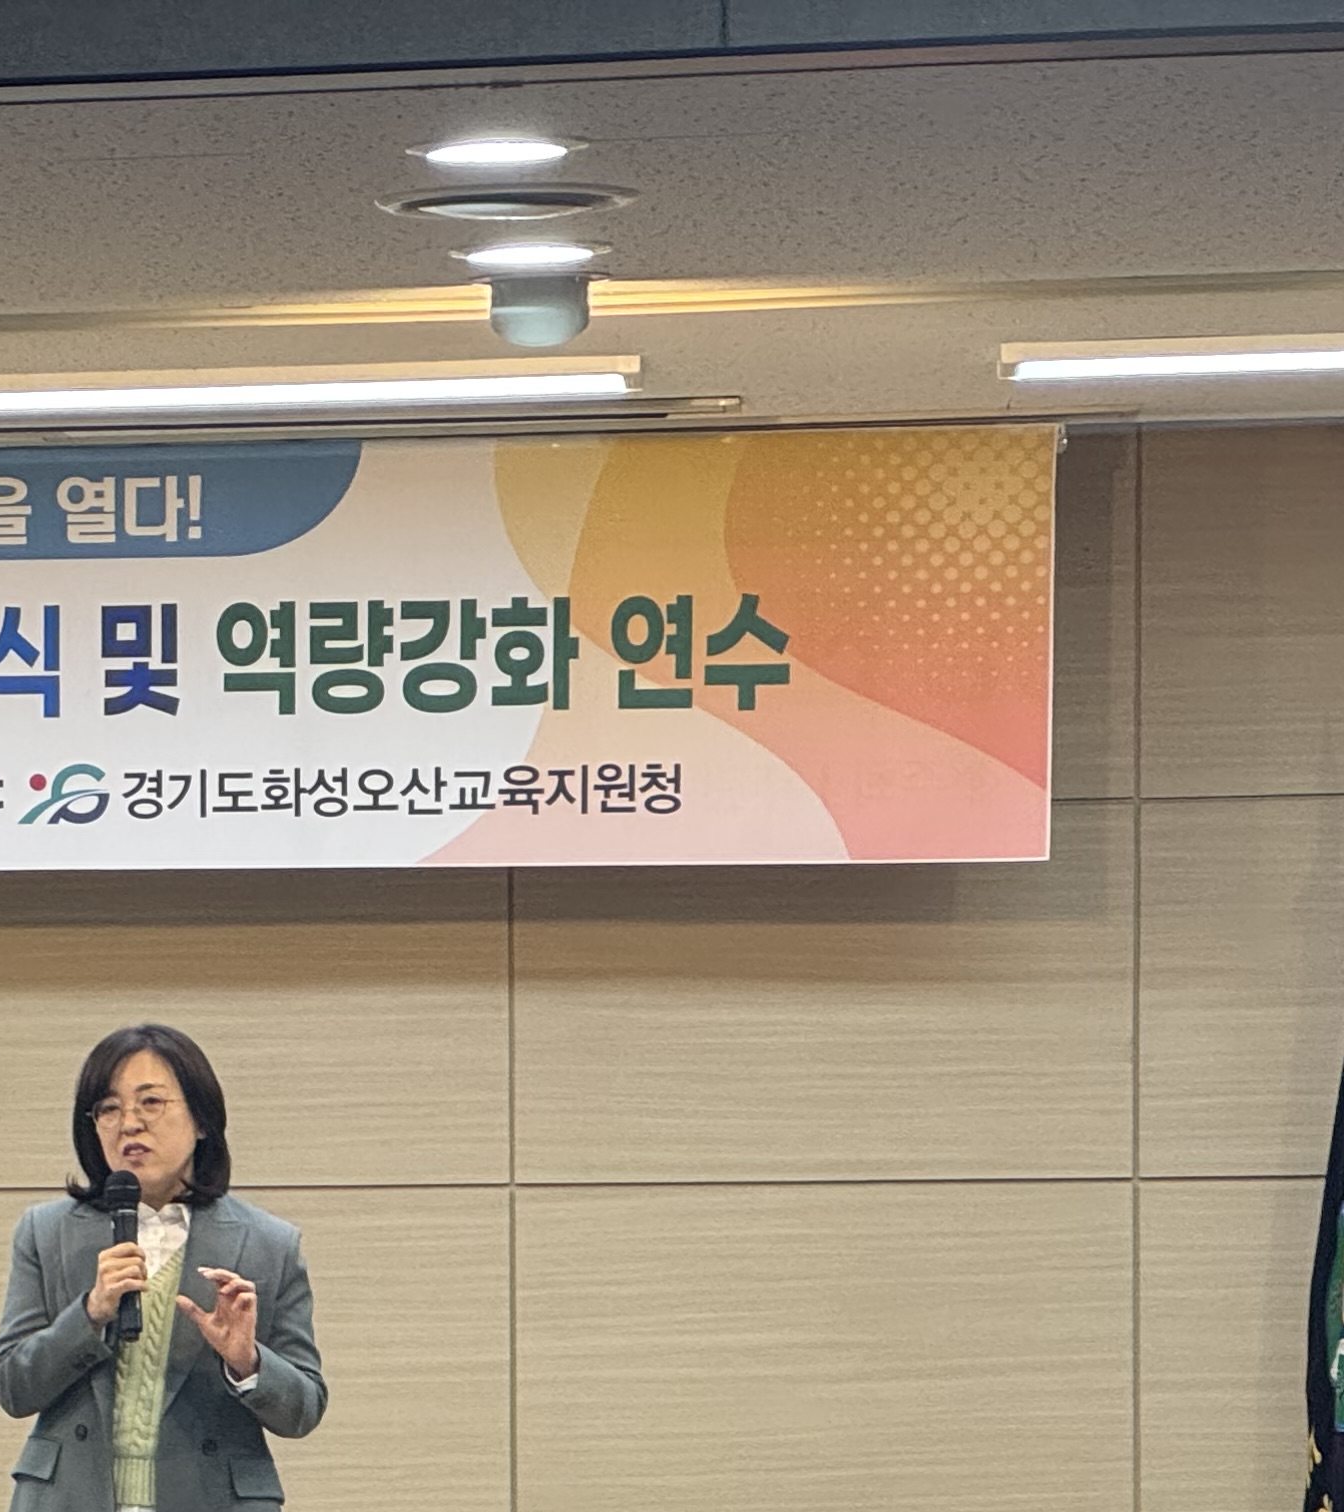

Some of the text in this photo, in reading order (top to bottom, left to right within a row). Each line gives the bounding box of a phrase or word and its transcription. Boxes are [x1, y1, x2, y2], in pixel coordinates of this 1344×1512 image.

[56, 474, 203, 544] 열다!
[100, 602, 180, 716] 및
[216, 596, 580, 715] 역량강화
[611, 593, 791, 712] 연수
[121, 762, 683, 820] 경기도화성오산교육지원청
